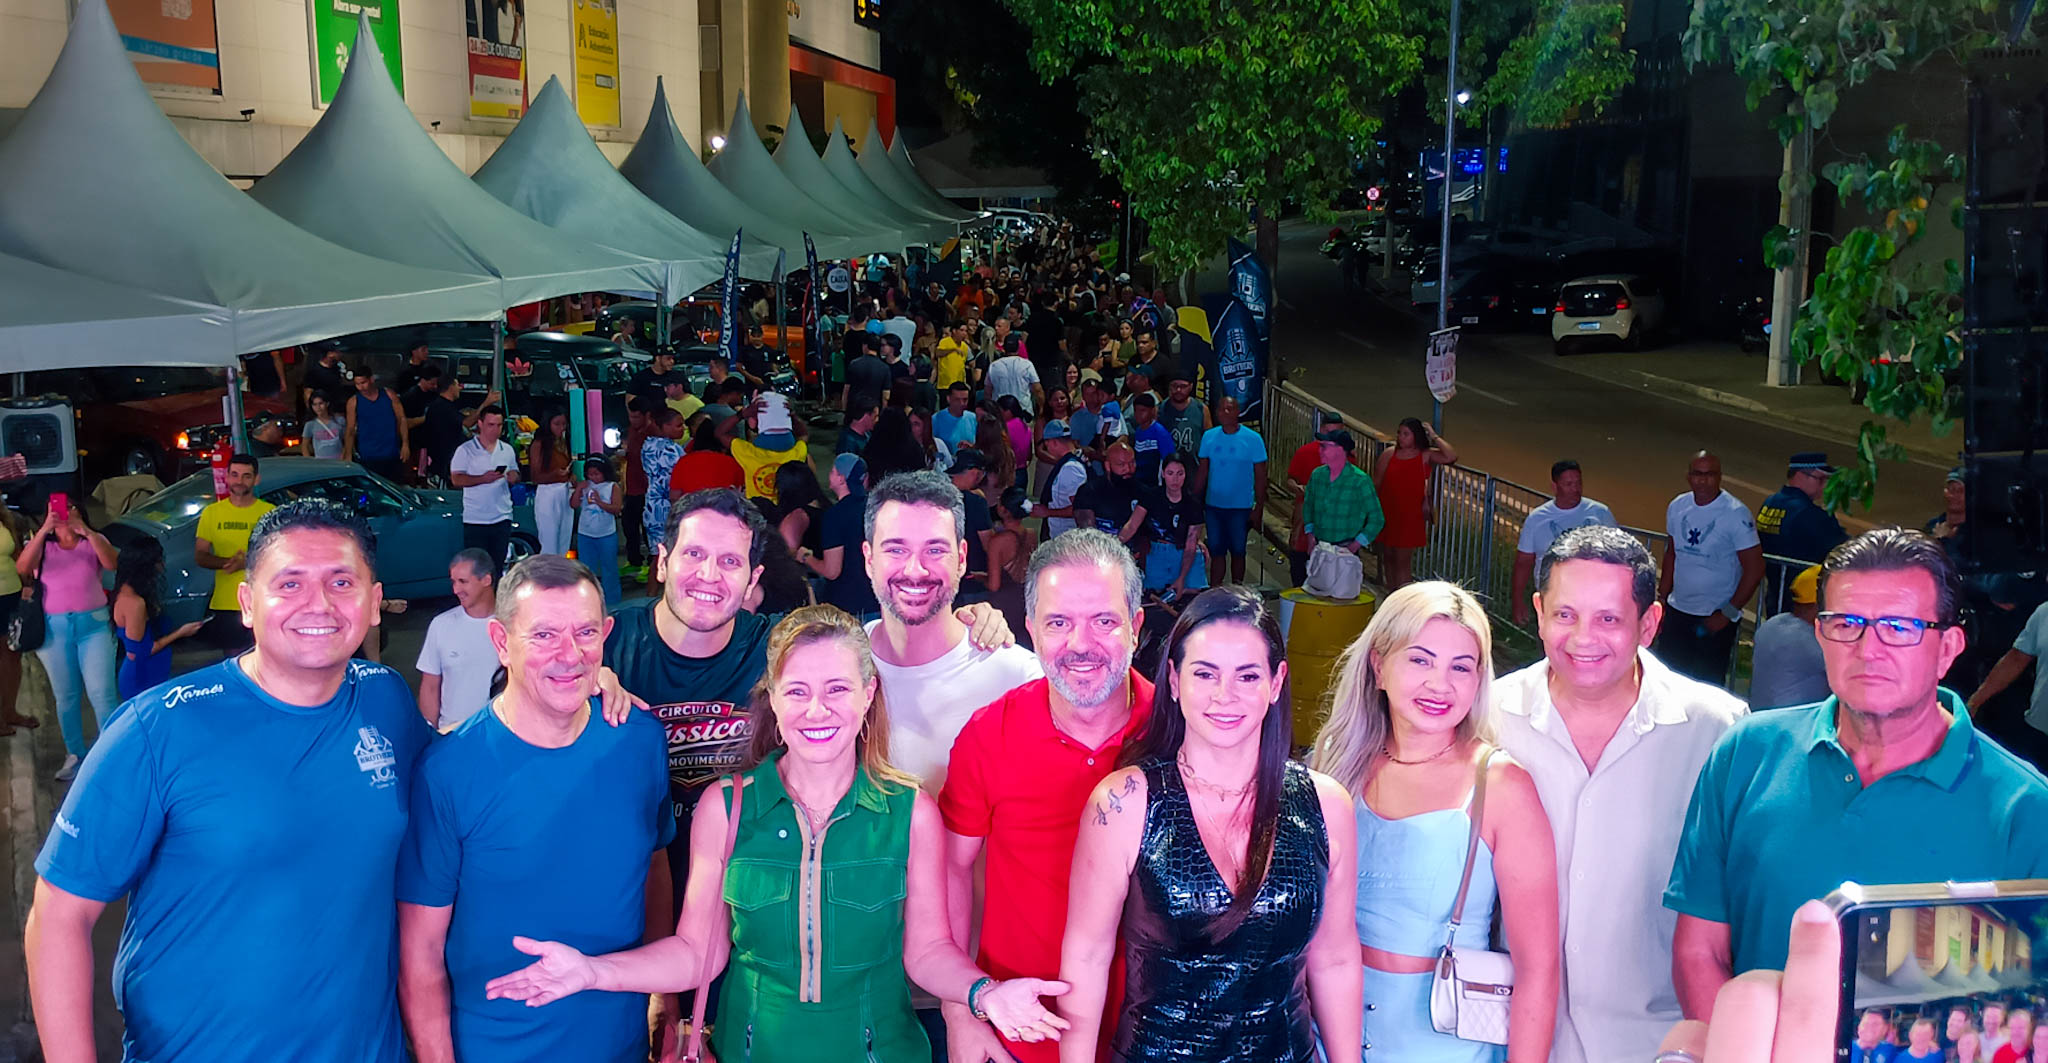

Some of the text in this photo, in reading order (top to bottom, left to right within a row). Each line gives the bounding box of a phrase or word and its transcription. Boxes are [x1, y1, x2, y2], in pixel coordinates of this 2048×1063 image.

[495, 44, 522, 60] OUTUBRO
[659, 704, 721, 718] CIRCUITO
[669, 755, 735, 767] MOVIMENTO
